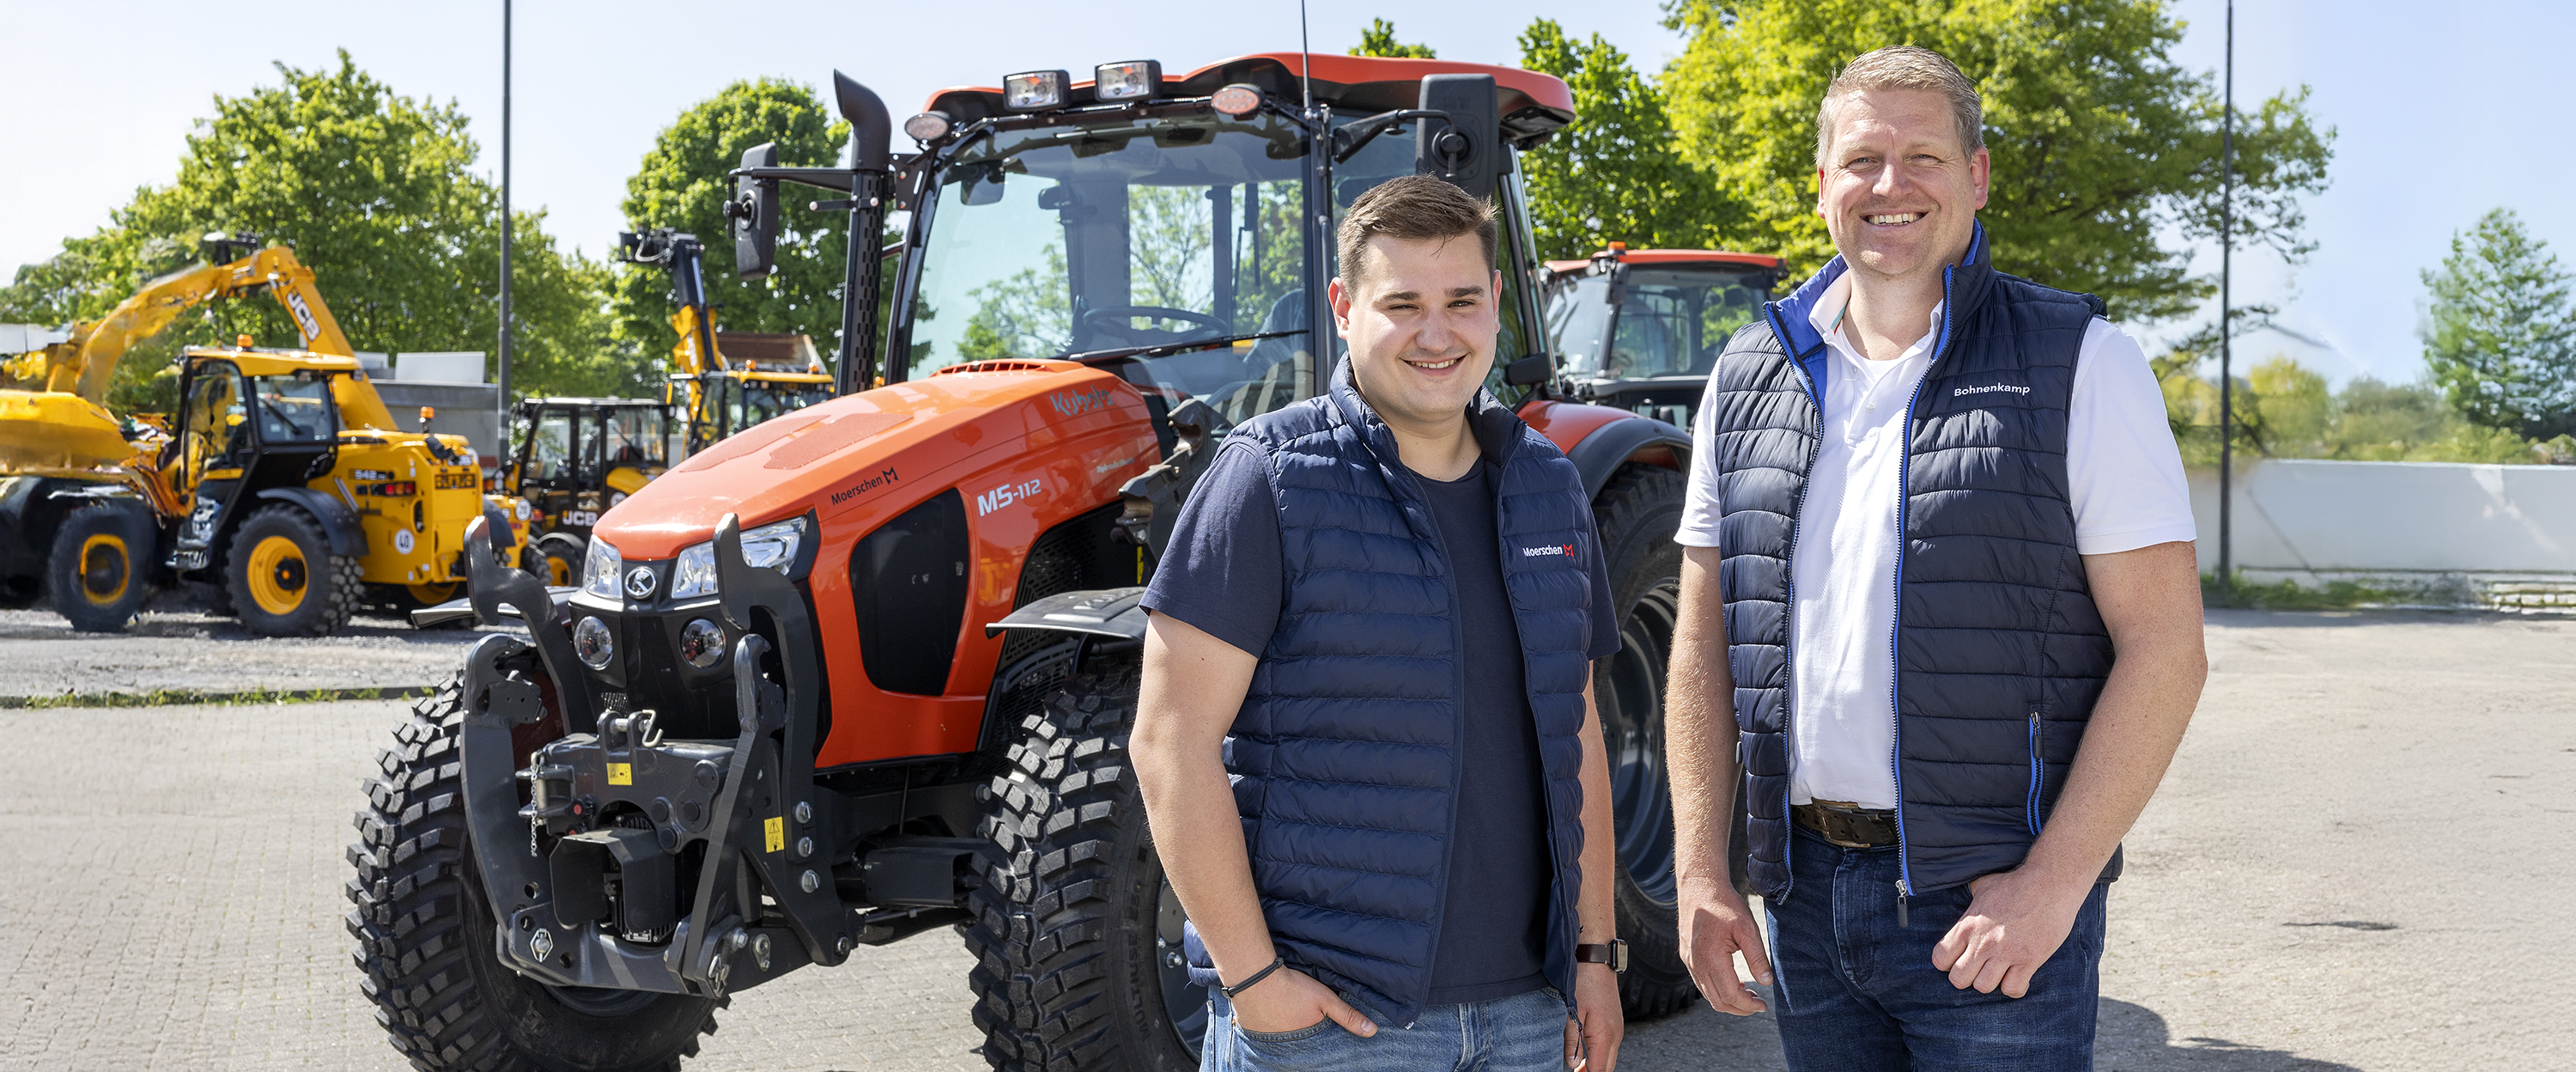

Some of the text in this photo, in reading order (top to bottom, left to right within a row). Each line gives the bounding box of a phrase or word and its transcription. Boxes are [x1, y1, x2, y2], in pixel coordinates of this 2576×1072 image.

[287, 286, 321, 341] JCB
[1954, 381, 2030, 396] Bohnenkamp
[1050, 385, 1114, 417] Kubota
[831, 476, 883, 506] Moerschen
[977, 478, 1042, 517] M5-112
[562, 510, 598, 527] JCB
[399, 533, 410, 549] 40
[1522, 545, 1563, 557] Moerschen
